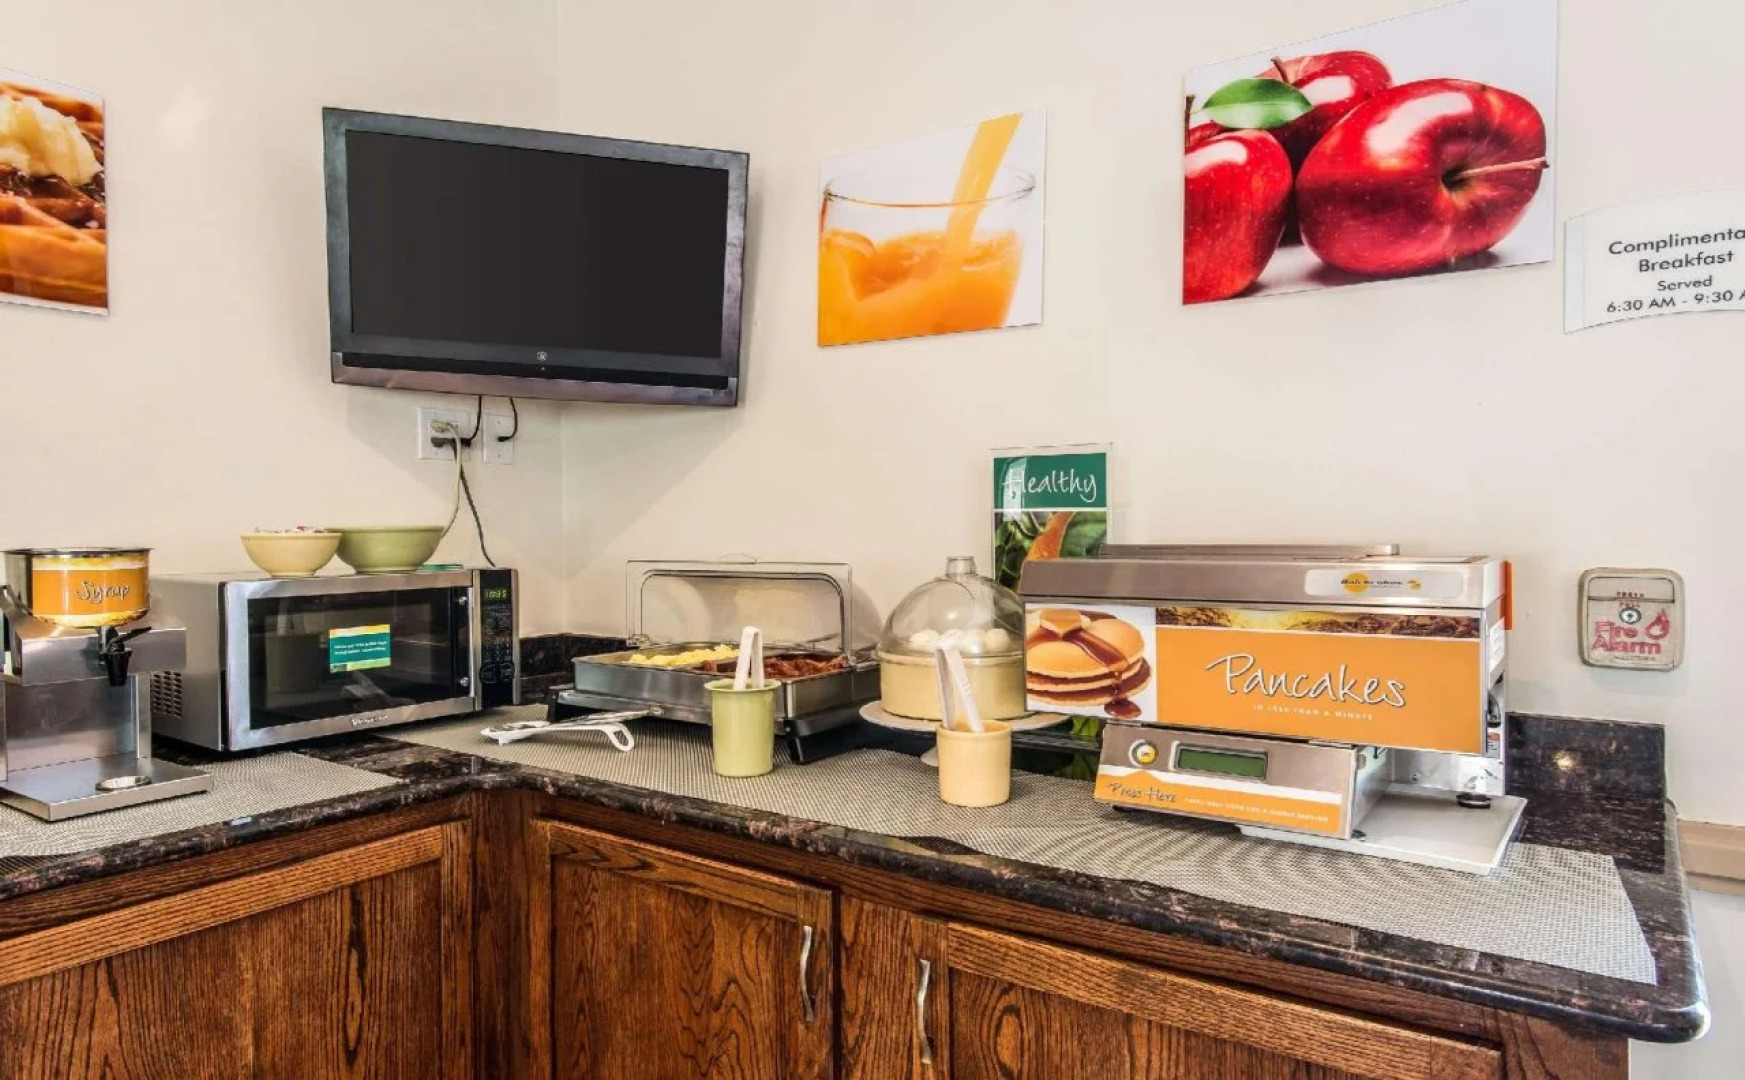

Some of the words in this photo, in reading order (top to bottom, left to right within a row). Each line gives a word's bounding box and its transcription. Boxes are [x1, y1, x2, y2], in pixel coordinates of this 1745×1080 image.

[1639, 251, 1734, 273] Breakfast
[1657, 275, 1713, 291] Served
[1606, 299, 1644, 313] 6:30
[1648, 296, 1676, 309] AM
[1694, 290, 1734, 305] 9:30
[1001, 468, 1097, 503] Healthy
[75, 580, 130, 604] Syrup
[1595, 621, 1638, 639] Fire
[1591, 632, 1662, 655] Alarm
[1205, 653, 1406, 708] Pancakes
[1107, 781, 1142, 799] Press
[1145, 786, 1177, 802] Here
